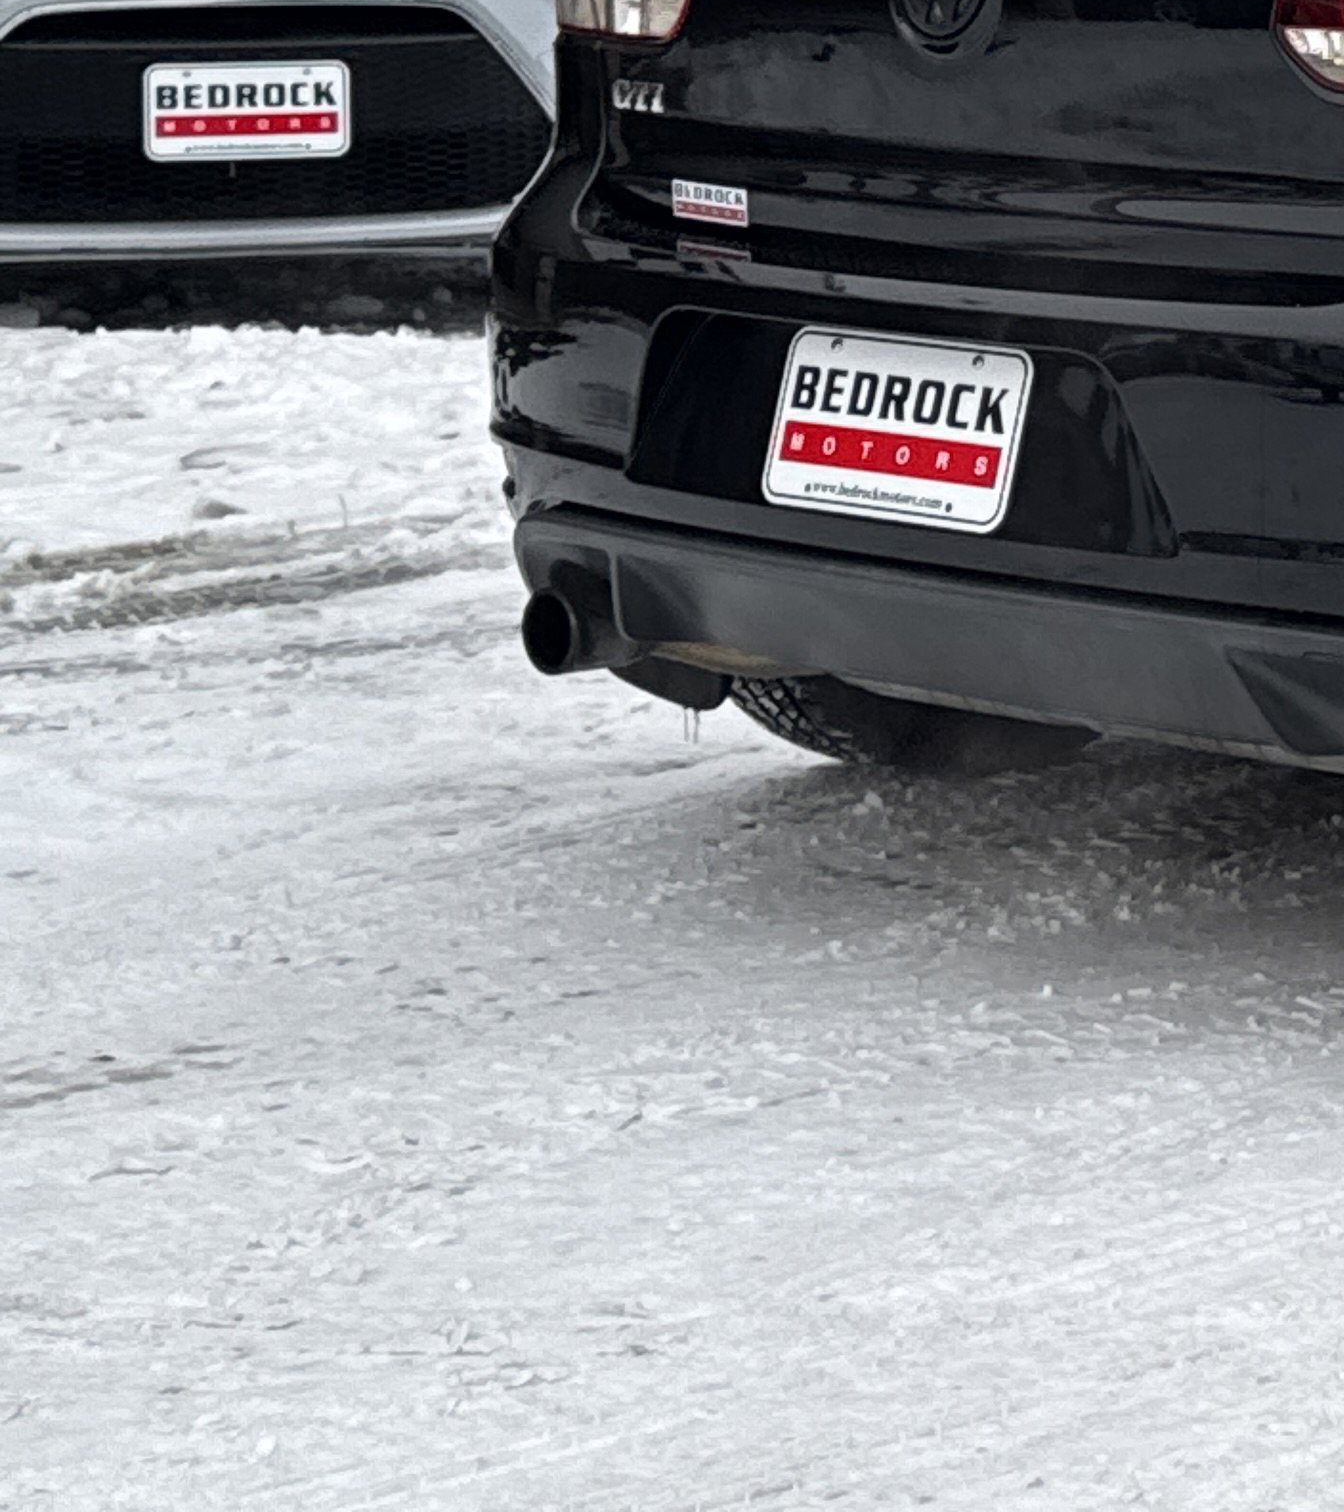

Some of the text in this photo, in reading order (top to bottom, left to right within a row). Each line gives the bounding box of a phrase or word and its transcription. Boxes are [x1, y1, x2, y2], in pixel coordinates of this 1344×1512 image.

[156, 81, 337, 110] BEDROCK
[612, 79, 664, 114] GTI
[790, 364, 1010, 435] BEDROCK
[789, 431, 989, 477] MOTORS
[812, 480, 943, 510] www.bedrockmotors.com
